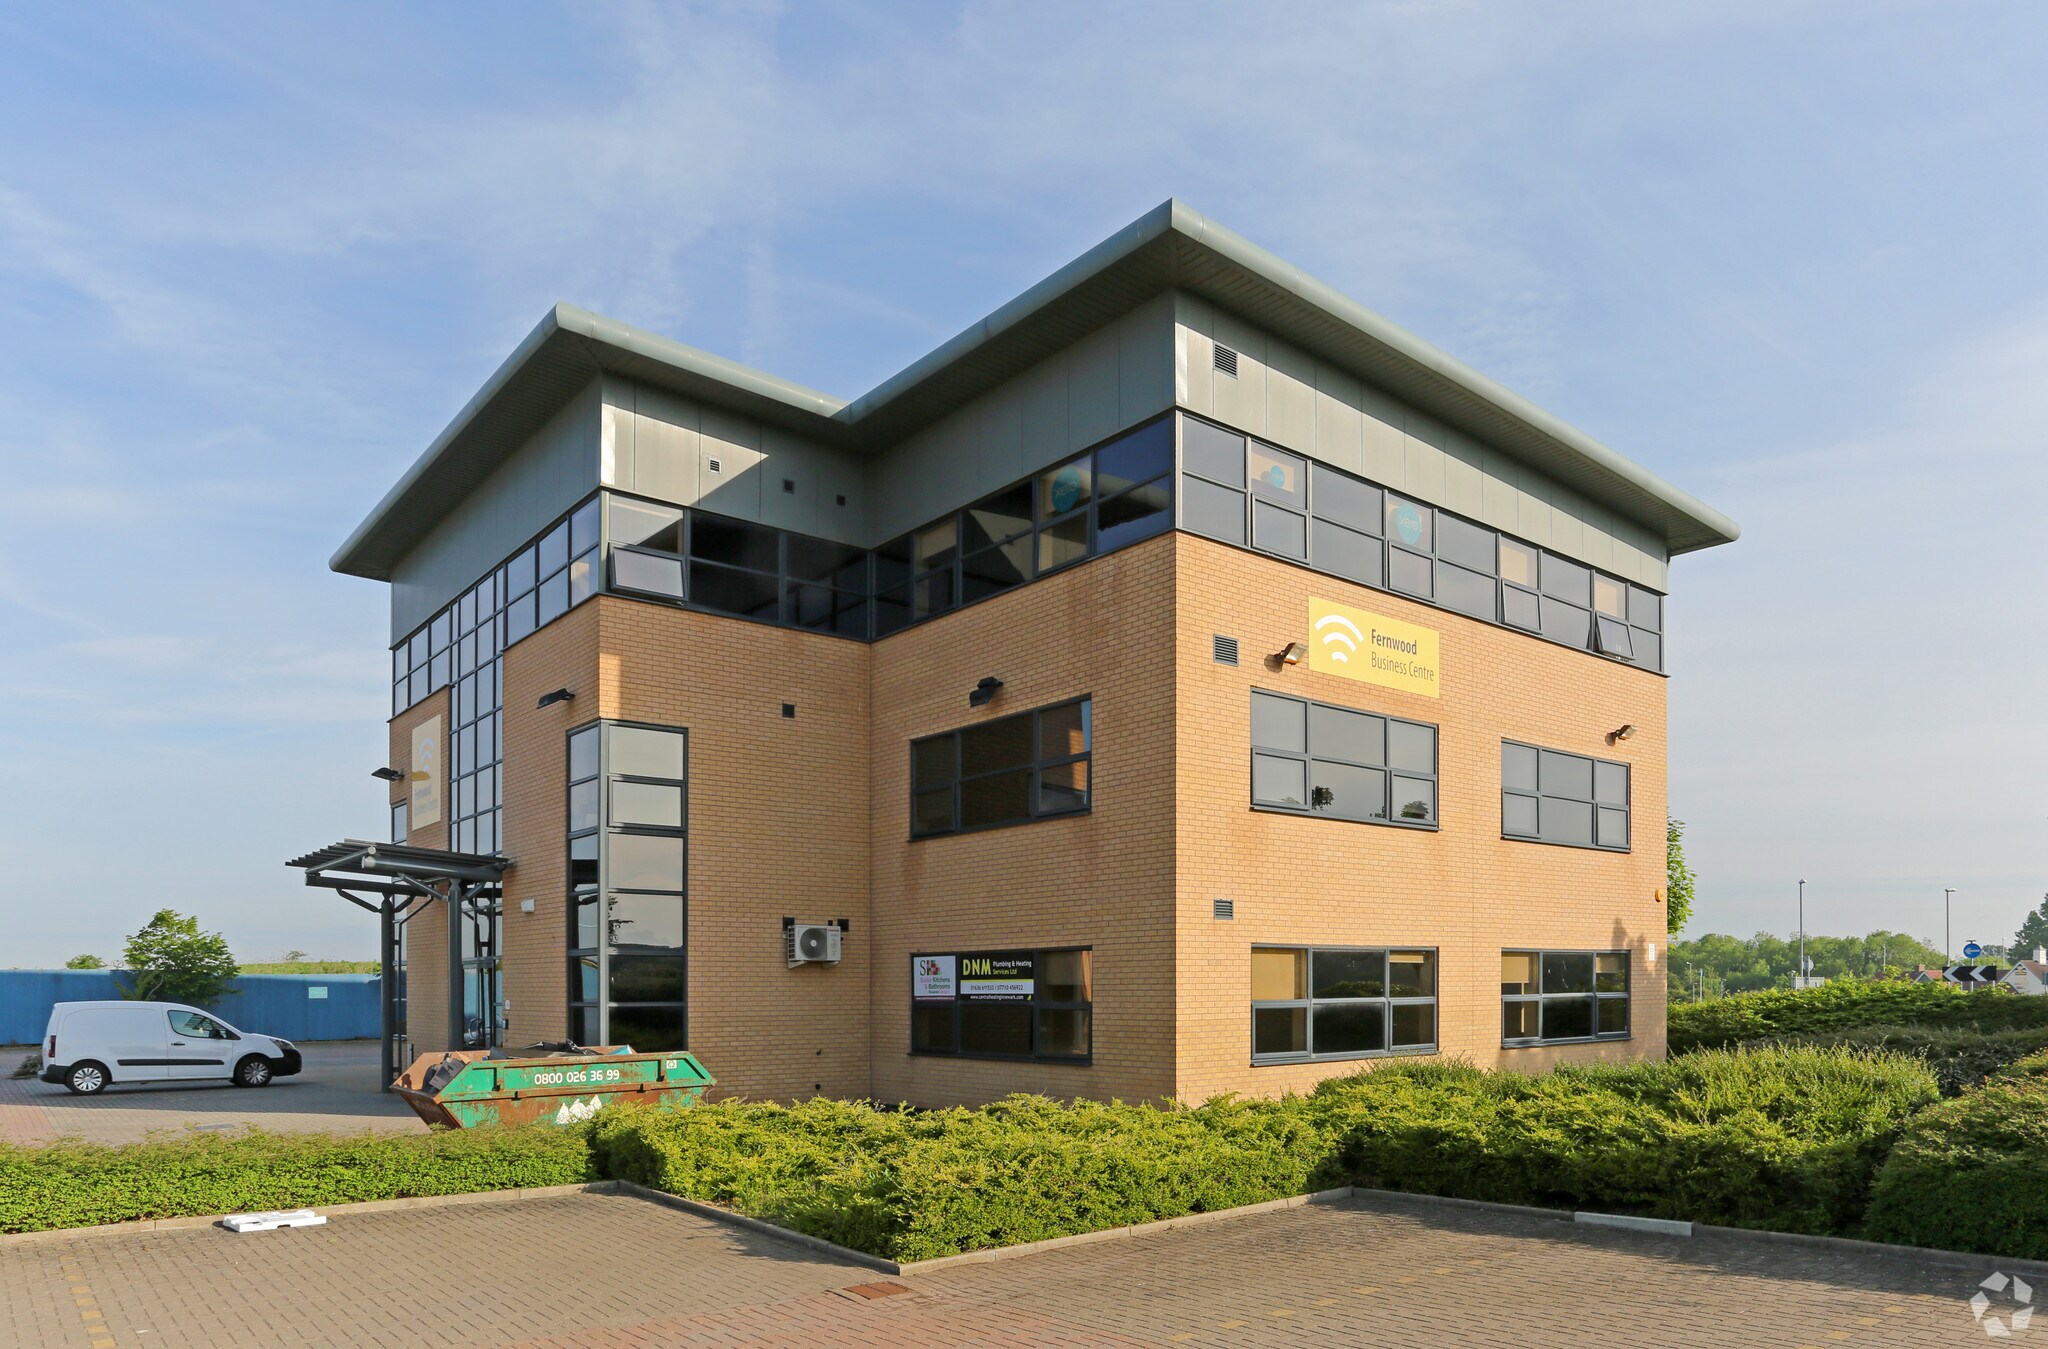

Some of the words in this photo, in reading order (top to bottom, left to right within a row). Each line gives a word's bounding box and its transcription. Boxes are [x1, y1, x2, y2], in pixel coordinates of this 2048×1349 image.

[1400, 517, 1419, 531] xero
[1371, 628, 1417, 655] Fernwood
[1371, 651, 1407, 675] Business
[1408, 661, 1434, 681] Centre
[963, 959, 991, 975] DNM
[534, 1072, 563, 1085] 0800
[566, 1071, 587, 1083] 026
[590, 1069, 603, 1081] 36
[606, 1069, 620, 1081] 99
